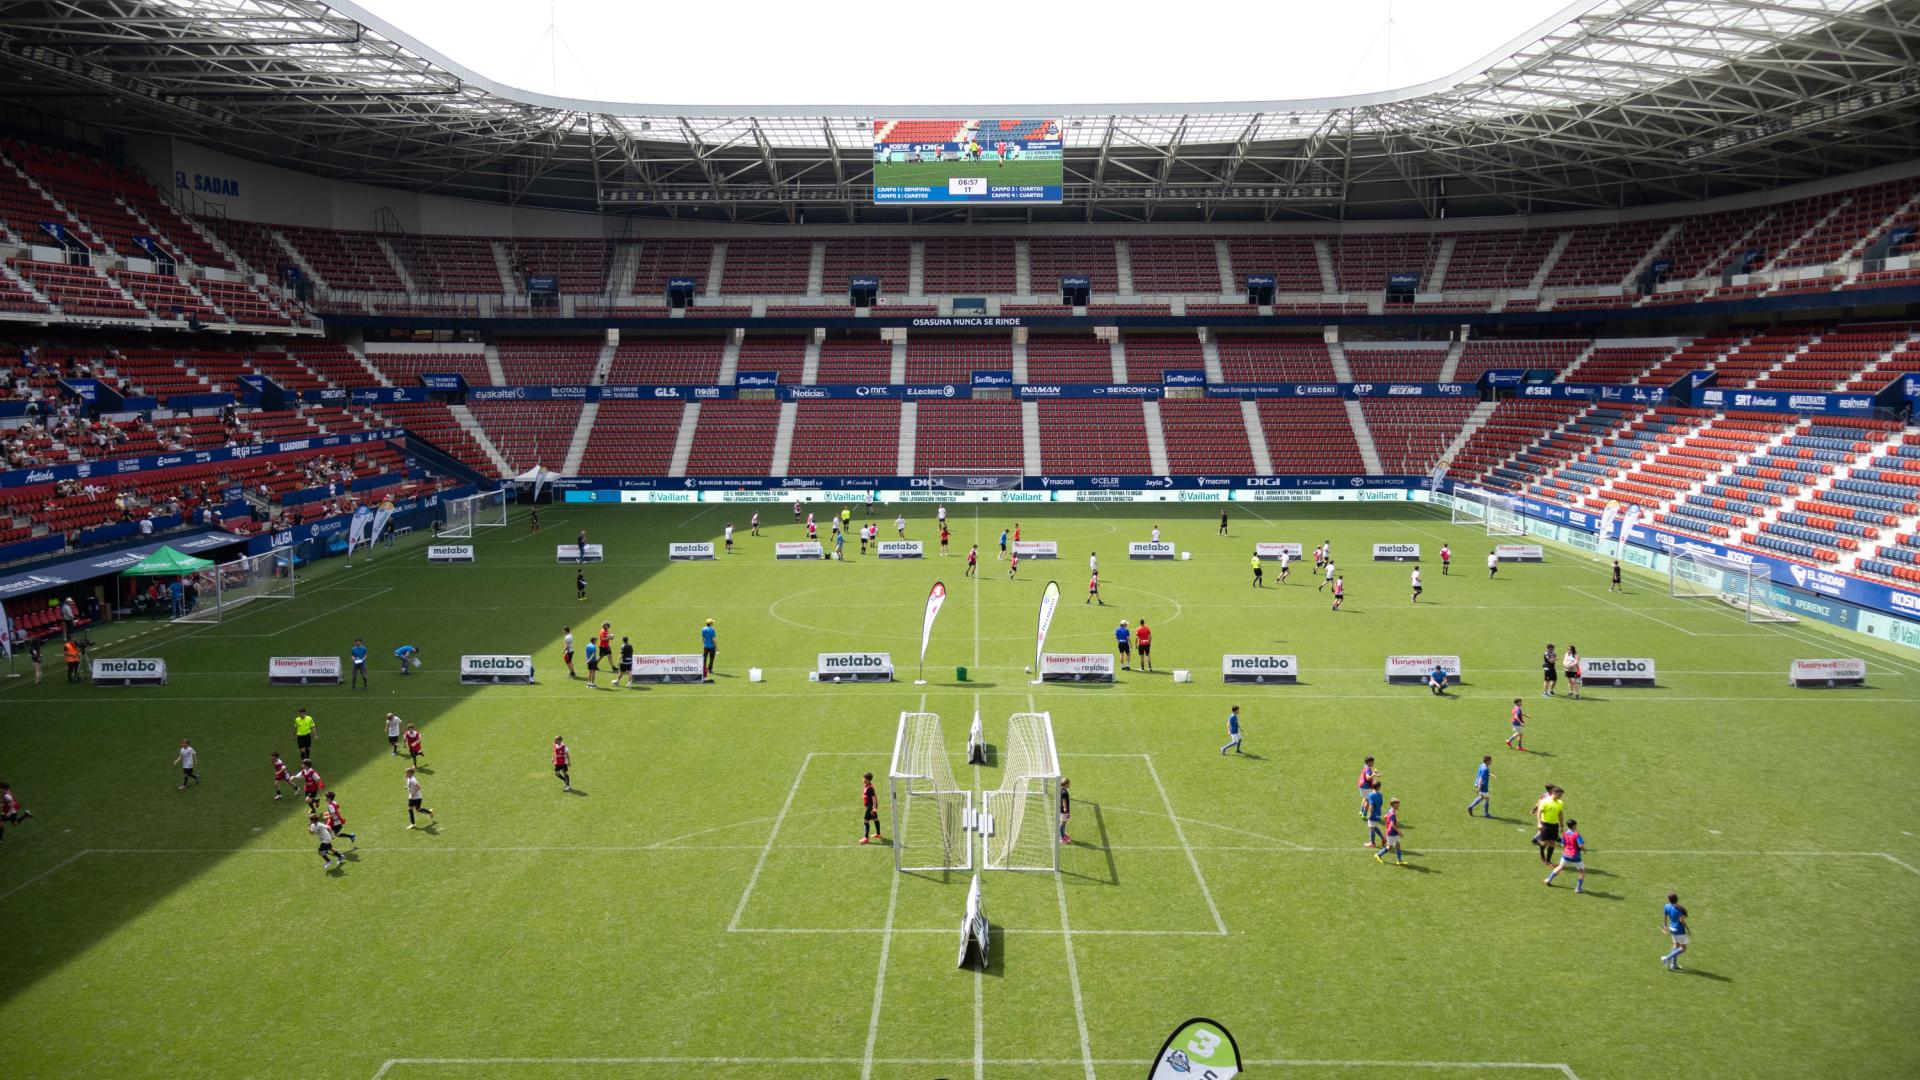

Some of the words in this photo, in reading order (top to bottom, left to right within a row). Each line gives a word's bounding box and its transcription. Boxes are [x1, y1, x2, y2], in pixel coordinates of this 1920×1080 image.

[176, 171, 189, 189] EL
[194, 174, 240, 196] SADAR
[1352, 384, 1373, 393] ATP
[476, 389, 516, 398] euskaltel
[1736, 395, 1752, 405] SRT
[657, 493, 689, 501] Vaillant
[833, 493, 865, 501] Vaillant
[1009, 492, 1042, 501] Vaillant
[1187, 492, 1220, 500] Vaillant
[1366, 491, 1399, 500] Vaillant
[433, 546, 468, 554] metabo
[1378, 545, 1414, 553] metabo
[1820, 573, 1846, 588] SADAR
[1795, 598, 1831, 616] XPERIENCE
[469, 657, 524, 669] metabo
[826, 655, 882, 667] metabo
[1046, 656, 1086, 664] Honeywell
[1231, 657, 1289, 669] metabo
[1392, 657, 1432, 666] Honeywell
[102, 660, 156, 672] metabo
[1588, 660, 1646, 672] metabo
[1188, 1028, 1221, 1058] 3
